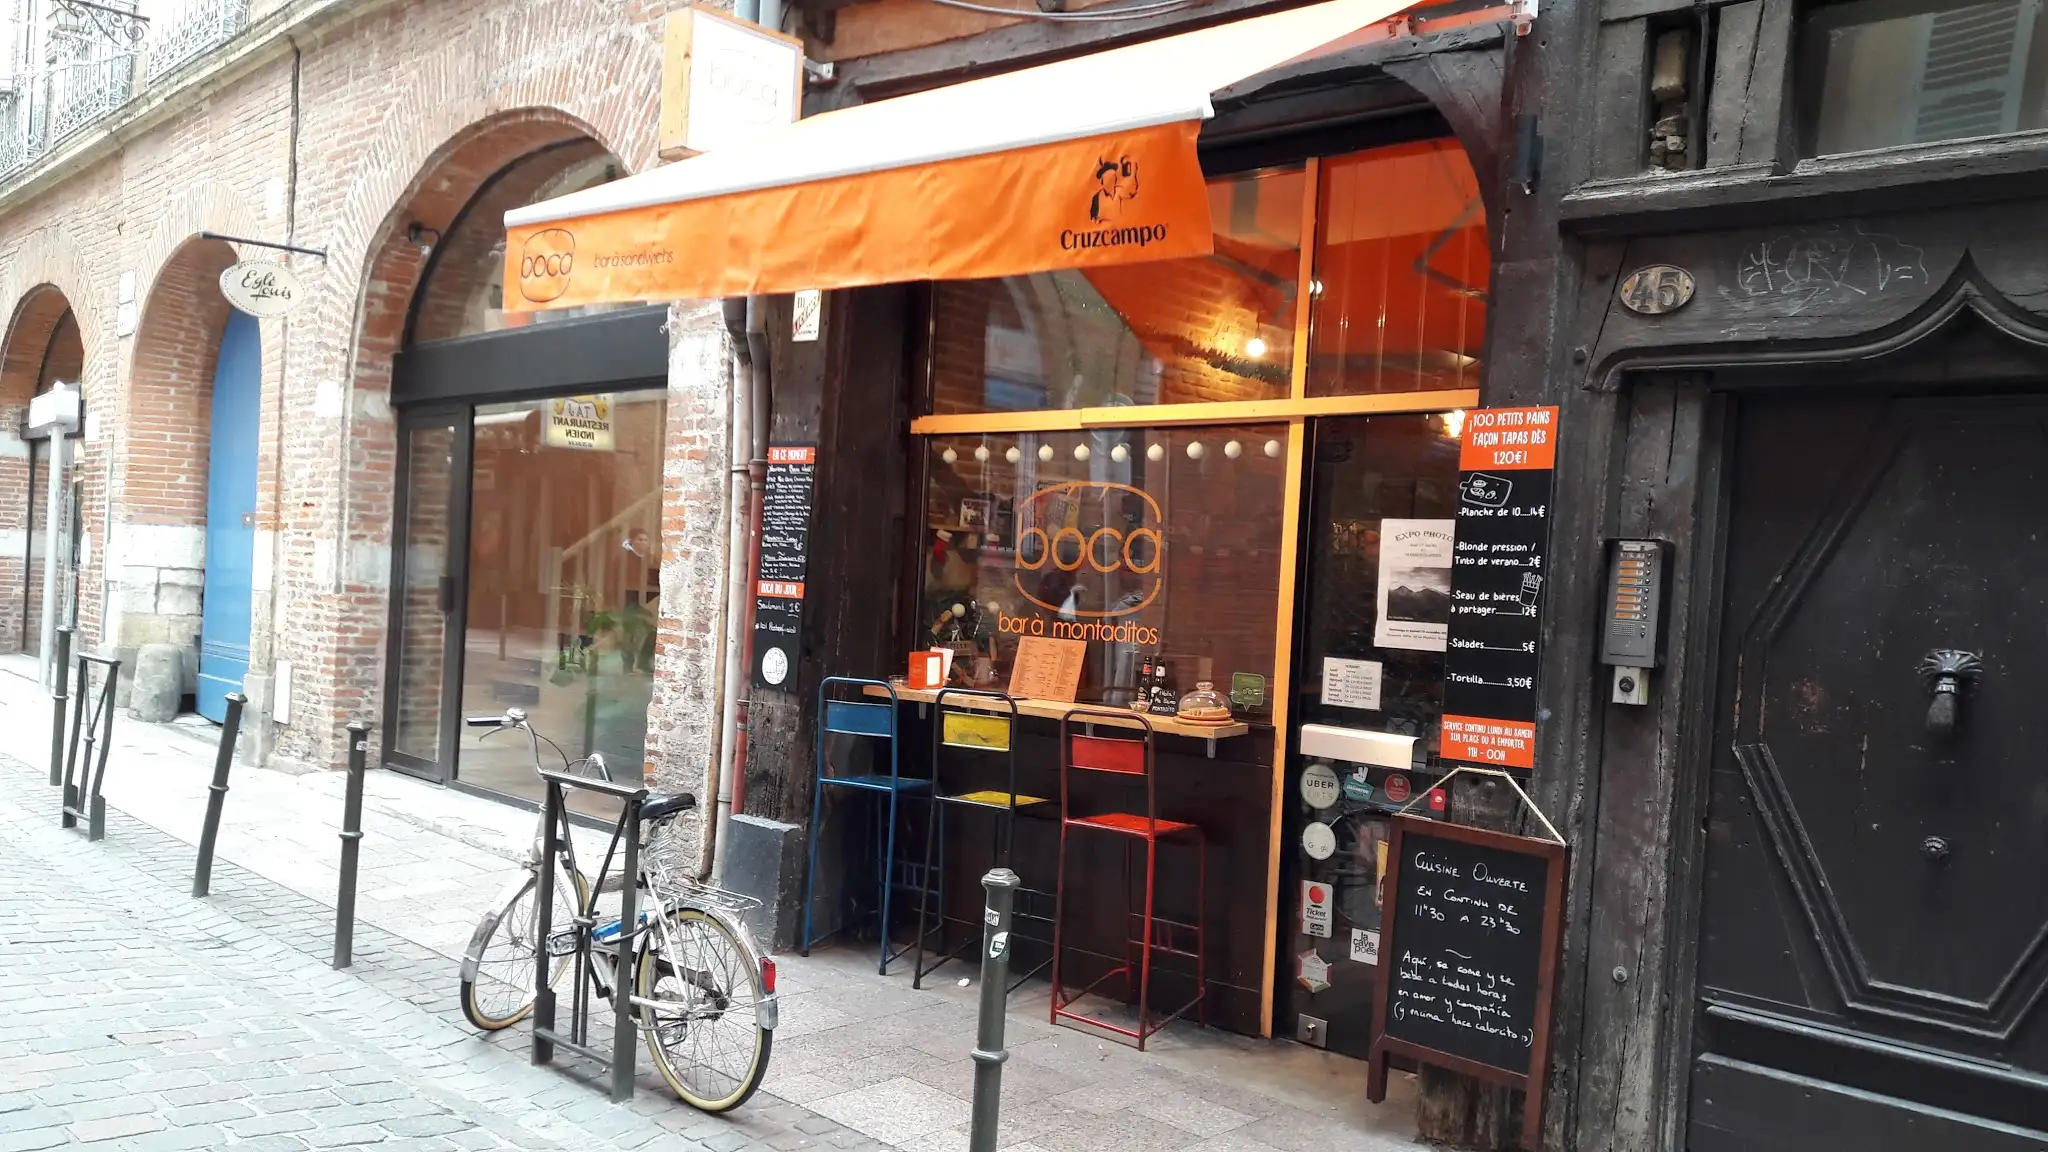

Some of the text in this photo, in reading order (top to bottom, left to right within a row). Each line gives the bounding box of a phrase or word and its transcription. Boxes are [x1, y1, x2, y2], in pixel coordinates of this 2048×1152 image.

[1060, 223, 1166, 251] Cruzcampo
[521, 249, 574, 279] boca
[1629, 271, 1681, 310] 45
[1497, 411, 1524, 426] PETITS
[1527, 410, 1551, 425] PAINS
[1472, 432, 1499, 448] FAÇON
[1501, 431, 1529, 445] TAPAS
[1497, 507, 1509, 517] de
[1015, 511, 1163, 574] boca
[1395, 530, 1454, 543] EXPO PHOTO
[1491, 544, 1528, 554] pression
[1455, 555, 1475, 565] Tinto
[1477, 556, 1488, 566] de
[1478, 591, 1491, 601] de
[1493, 592, 1520, 603] bières
[1450, 603, 1456, 613] à
[998, 611, 1159, 645] bar à montaditos
[1444, 720, 1464, 732] SERVICE
[1465, 723, 1486, 734] CONTINU
[1504, 727, 1513, 737] AU
[1514, 728, 1533, 739] SAMEDI
[1450, 732, 1461, 744] SUR
[1462, 733, 1480, 744] PLACE
[1481, 735, 1489, 745] OU
[1497, 737, 1525, 751] EMPORTER
[1306, 779, 1334, 790] UBER
[1306, 907, 1327, 918] Ticket
[1498, 903, 1518, 916] DE
[1353, 938, 1375, 949] cave
[1360, 931, 1369, 941] la
[1436, 960, 1449, 970] se
[1457, 966, 1482, 978] come
[1486, 972, 1496, 988] y
[1499, 974, 1516, 987] se
[1400, 966, 1424, 983] bebe
[1428, 976, 1437, 984] a
[1476, 982, 1507, 1002] horas
[1398, 989, 1409, 998] en
[1413, 992, 1437, 1002] amor
[1444, 997, 1454, 1014] y
[1451, 1013, 1473, 1029] hace
[1476, 1020, 1518, 1041] calorcito
